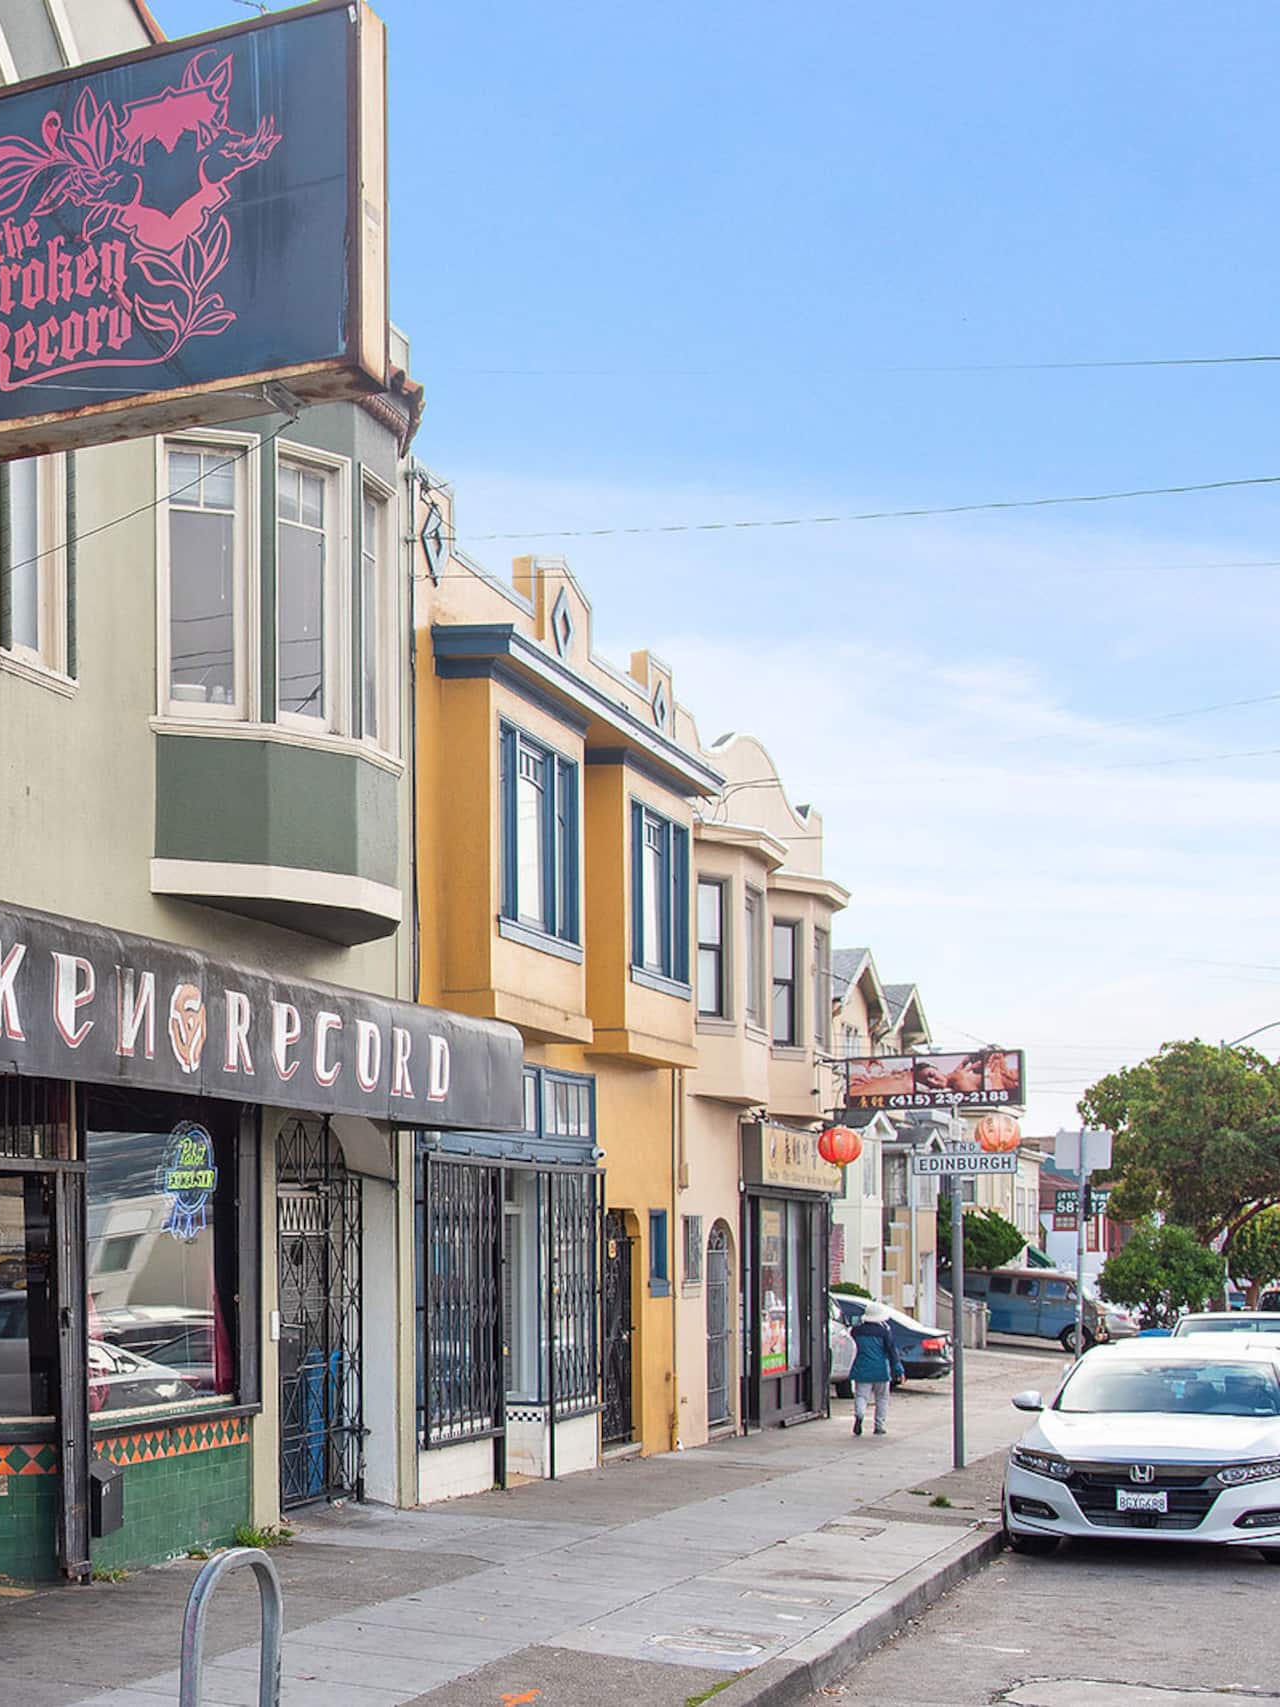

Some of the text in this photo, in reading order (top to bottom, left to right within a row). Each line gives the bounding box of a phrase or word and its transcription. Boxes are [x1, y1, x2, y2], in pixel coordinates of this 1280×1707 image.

[889, 1095, 931, 1107] (415)
[935, 1091, 1009, 1105] 239-2188
[920, 1157, 1012, 1171] EDINBURGH
